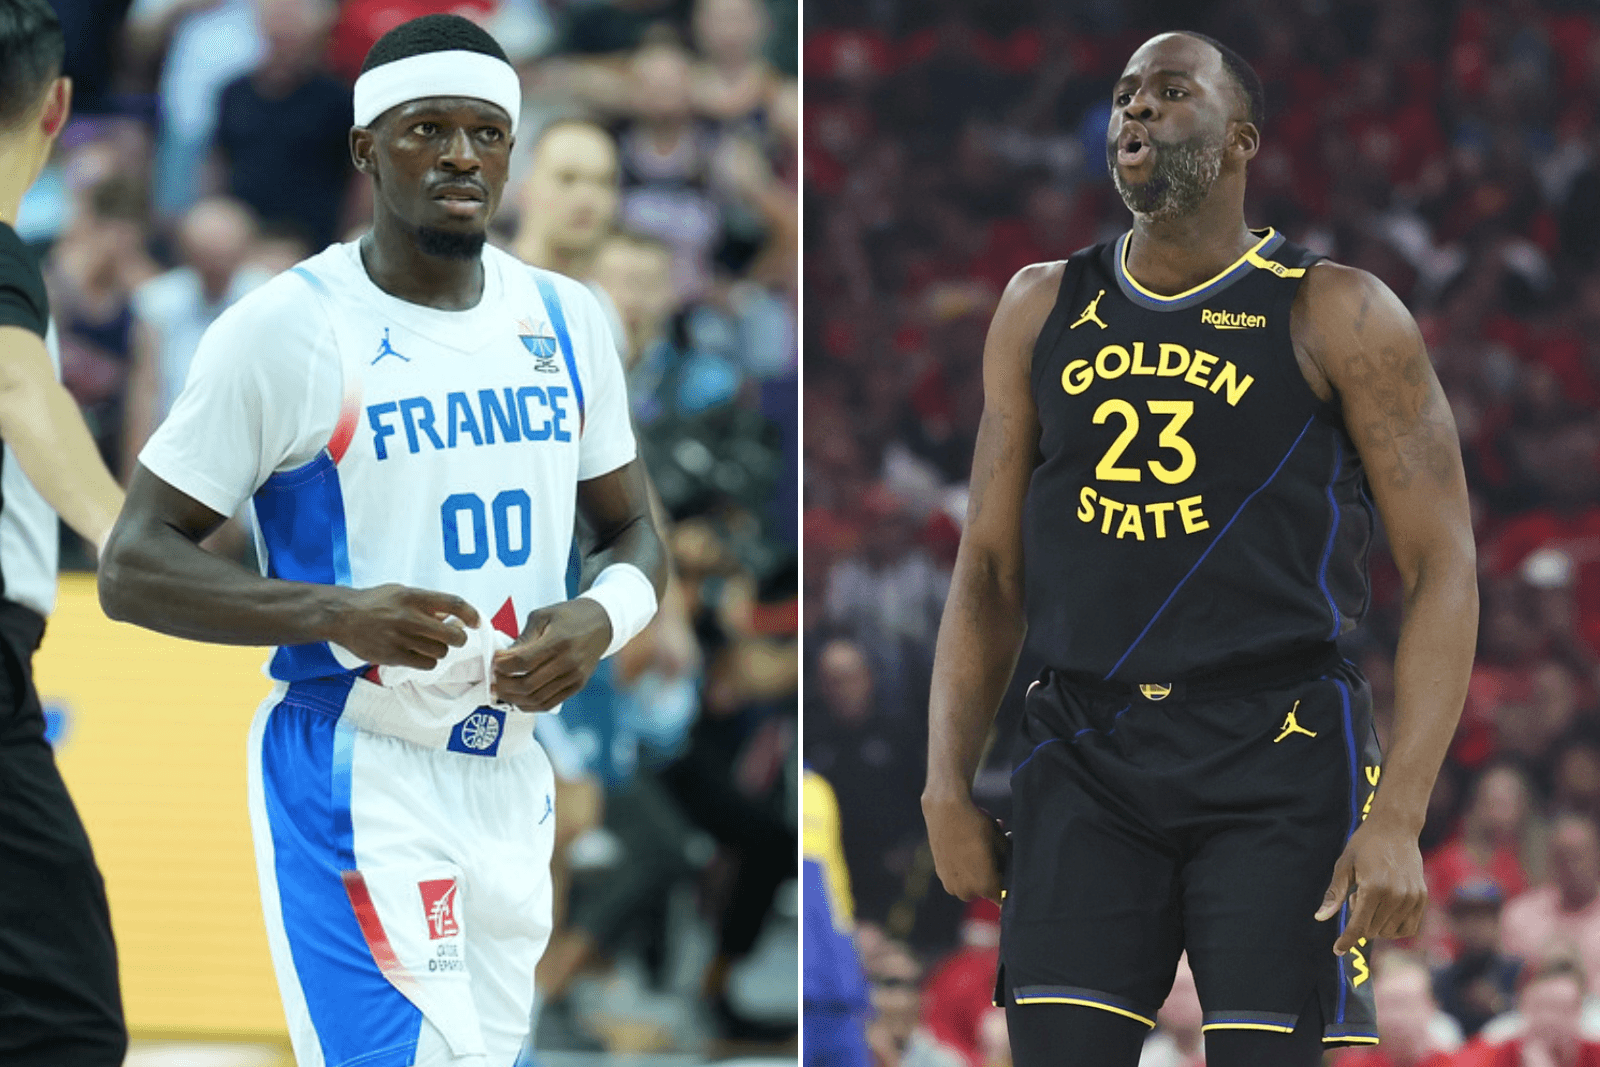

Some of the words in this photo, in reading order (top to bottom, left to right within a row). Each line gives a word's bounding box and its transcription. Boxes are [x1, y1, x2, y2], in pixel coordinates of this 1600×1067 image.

[1201, 309, 1266, 329] Rakuten
[1061, 342, 1254, 406] GOLDEN
[366, 386, 571, 460] FRANCE
[1092, 398, 1197, 484] 23
[440, 488, 532, 571] 00
[1077, 486, 1210, 541] STATE
